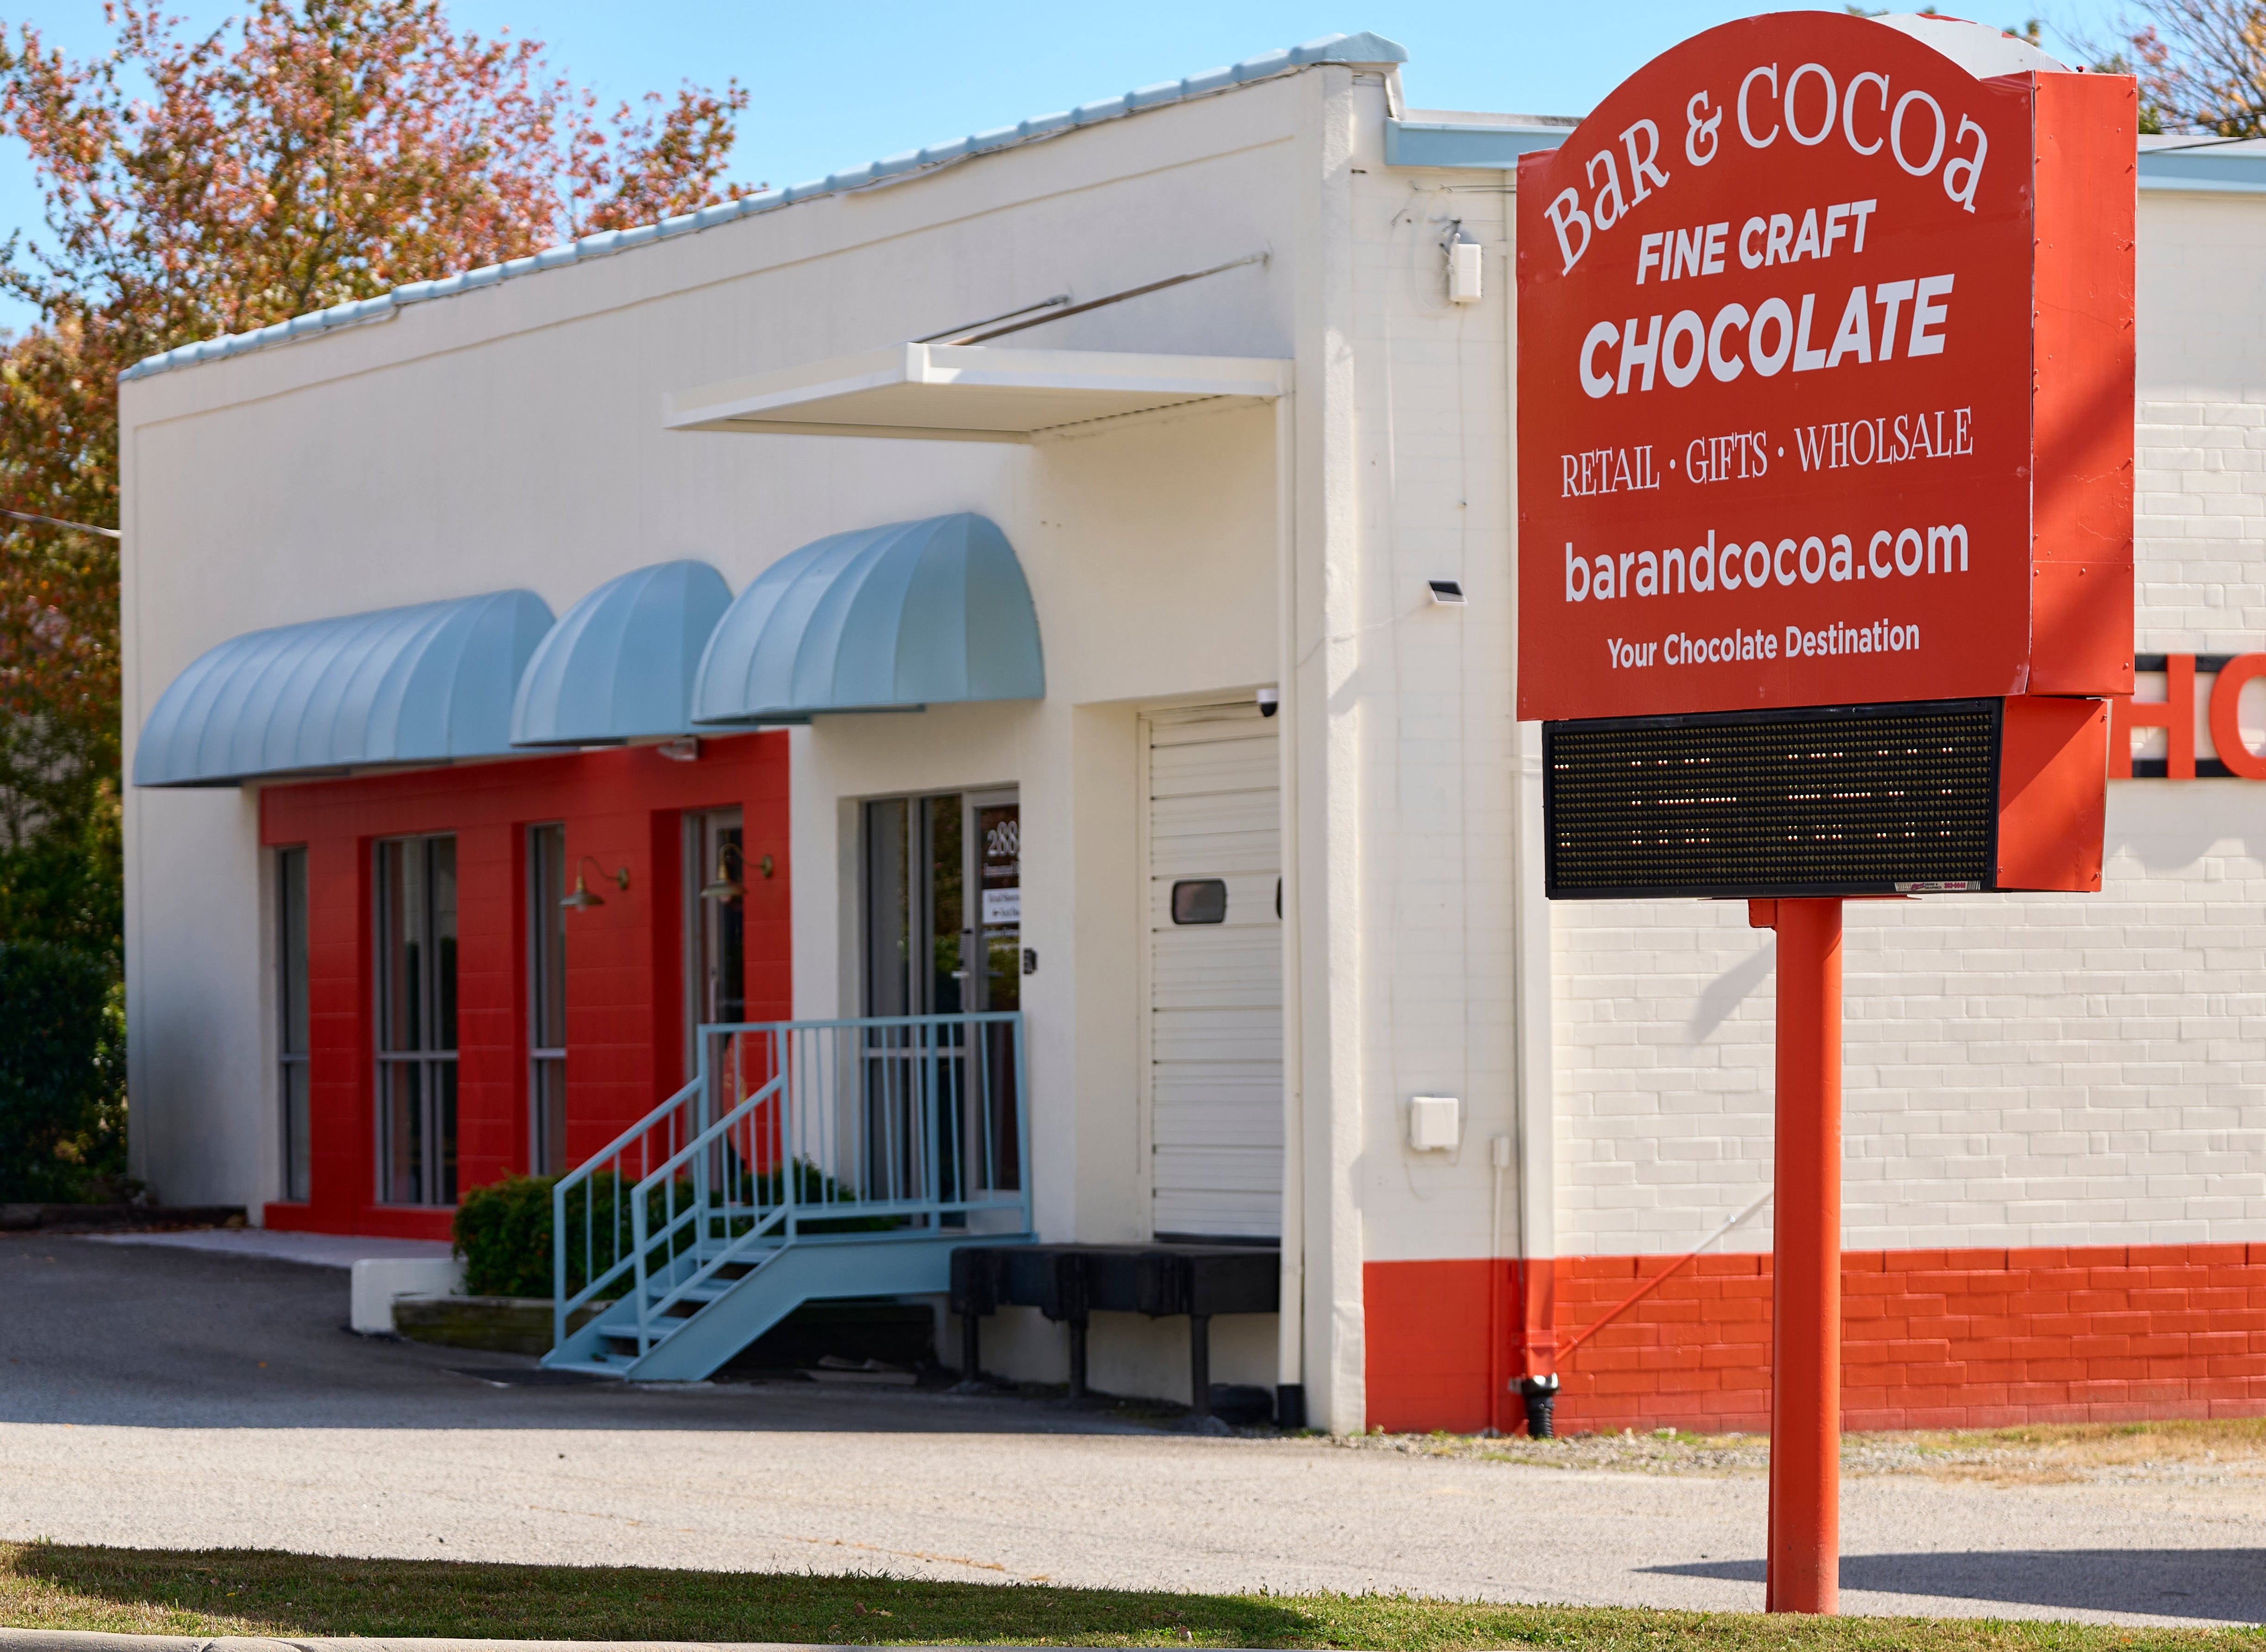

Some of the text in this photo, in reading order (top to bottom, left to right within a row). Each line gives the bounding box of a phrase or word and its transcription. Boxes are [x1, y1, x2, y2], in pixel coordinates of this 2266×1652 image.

[1685, 90, 1722, 167] &
[1636, 199, 1877, 285] FINE CRAFT
[1580, 273, 1955, 398] CHOCOLATE
[1561, 406, 1973, 497] RETAIL GIFTS WHOLSALE
[1566, 524, 1968, 602] barandcocoa.com
[1608, 619, 1919, 669] Your Chocolate Destination
[987, 820, 1020, 857] 288
